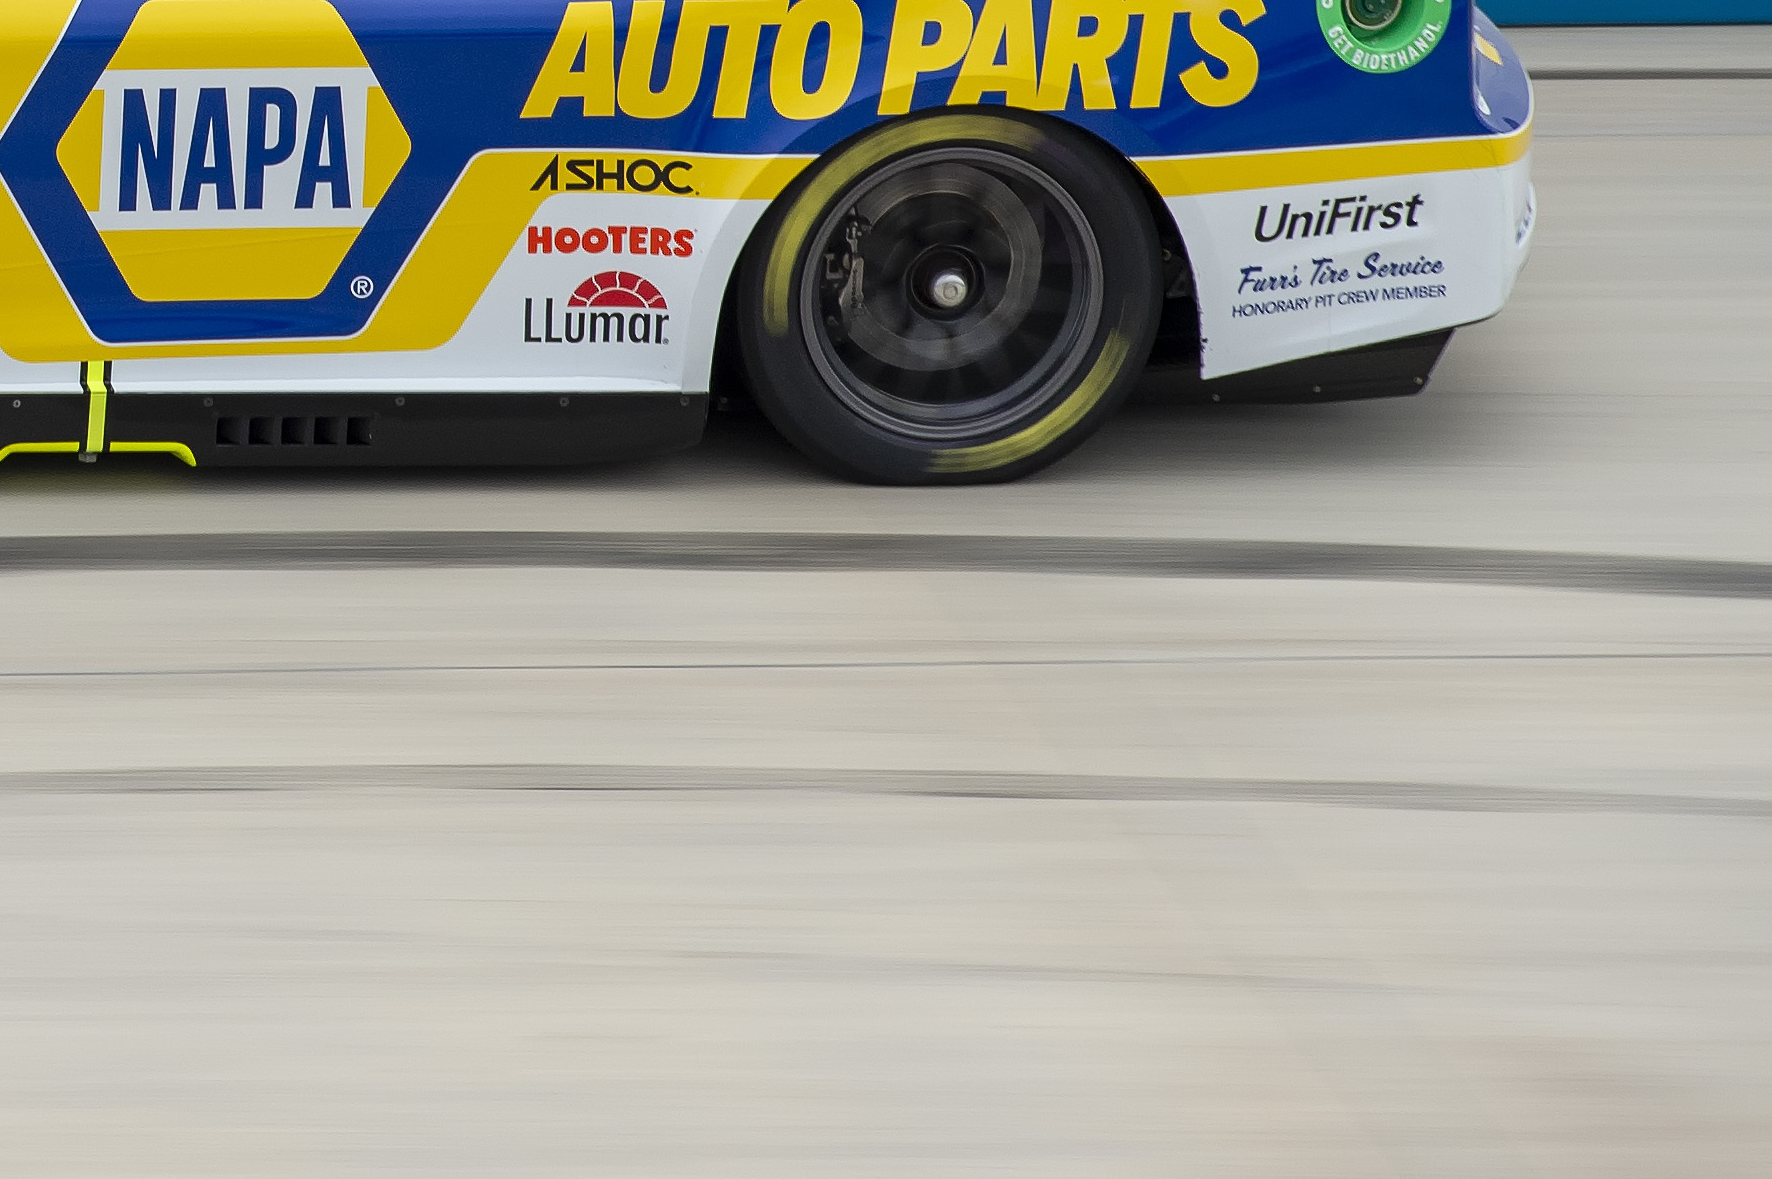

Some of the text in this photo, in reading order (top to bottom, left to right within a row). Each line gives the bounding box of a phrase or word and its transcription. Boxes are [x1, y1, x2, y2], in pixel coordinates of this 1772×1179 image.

[1328, 19, 1443, 70] GET BIOETHANOL
[117, 86, 352, 211] NAPA
[530, 154, 694, 194] ASHOC
[1254, 194, 1424, 243] UniFirst
[528, 225, 695, 258] HOOTERS
[1311, 257, 1355, 287] Tire
[1357, 252, 1445, 280] Service
[1232, 284, 1447, 318] HONORARY PIT CREW MEMBER
